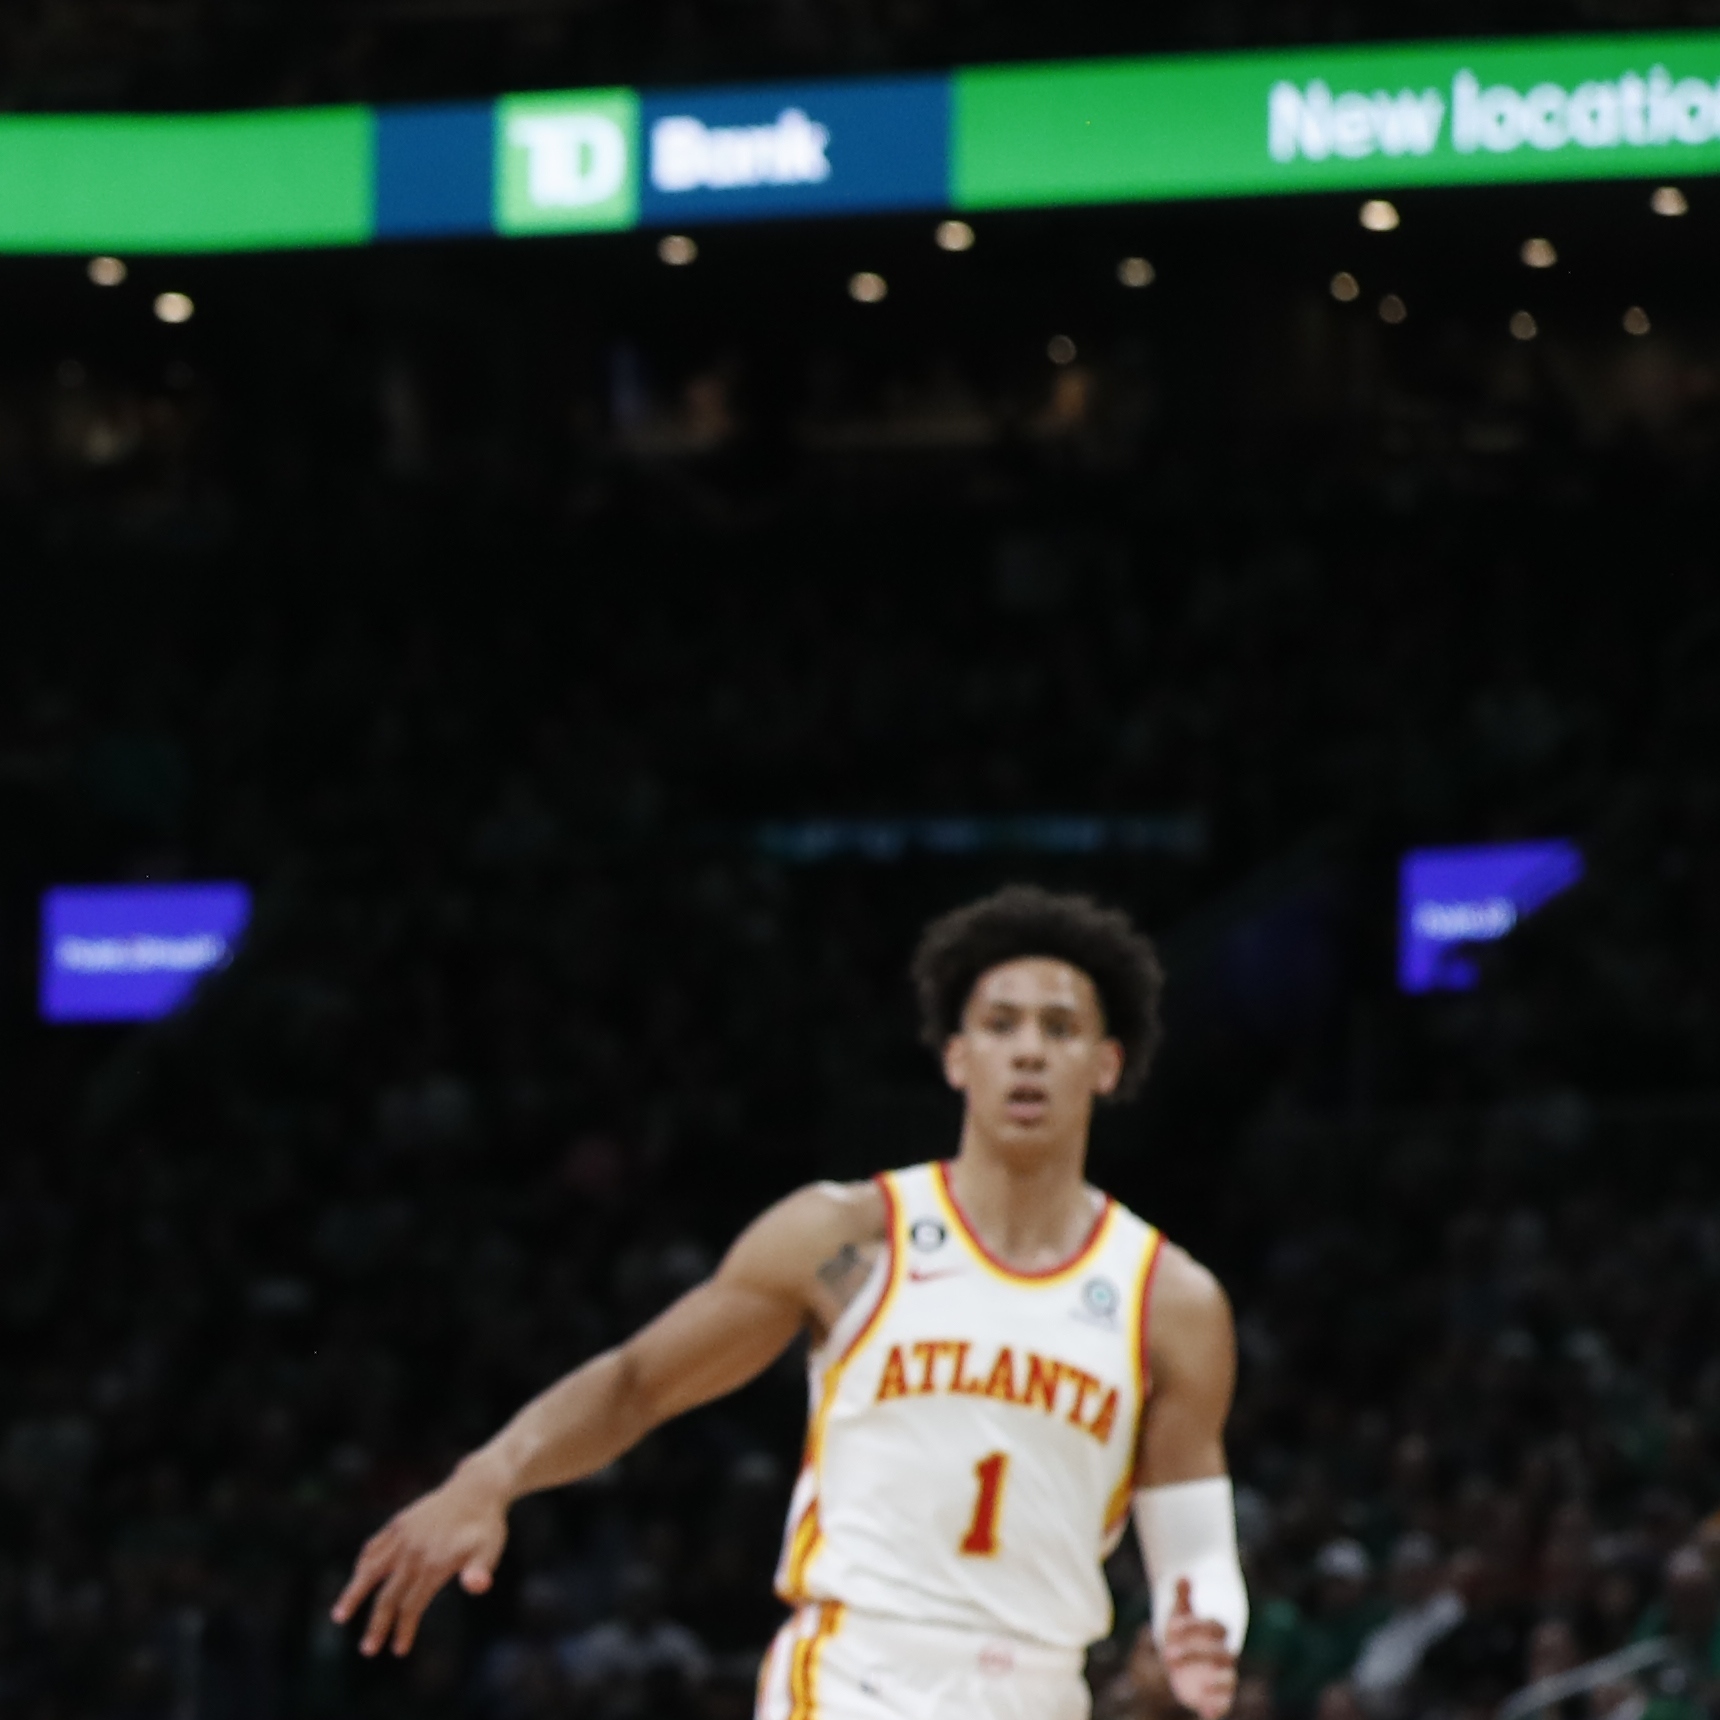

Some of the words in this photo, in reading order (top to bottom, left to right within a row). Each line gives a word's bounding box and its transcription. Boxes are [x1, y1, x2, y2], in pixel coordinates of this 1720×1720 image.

[508, 112, 628, 208] TD
[650, 106, 832, 193] Bank
[1269, 77, 1446, 163] New
[1452, 63, 1720, 155] locatio
[877, 1340, 1121, 1446] ATLANTA
[958, 1450, 1009, 1560] 1
